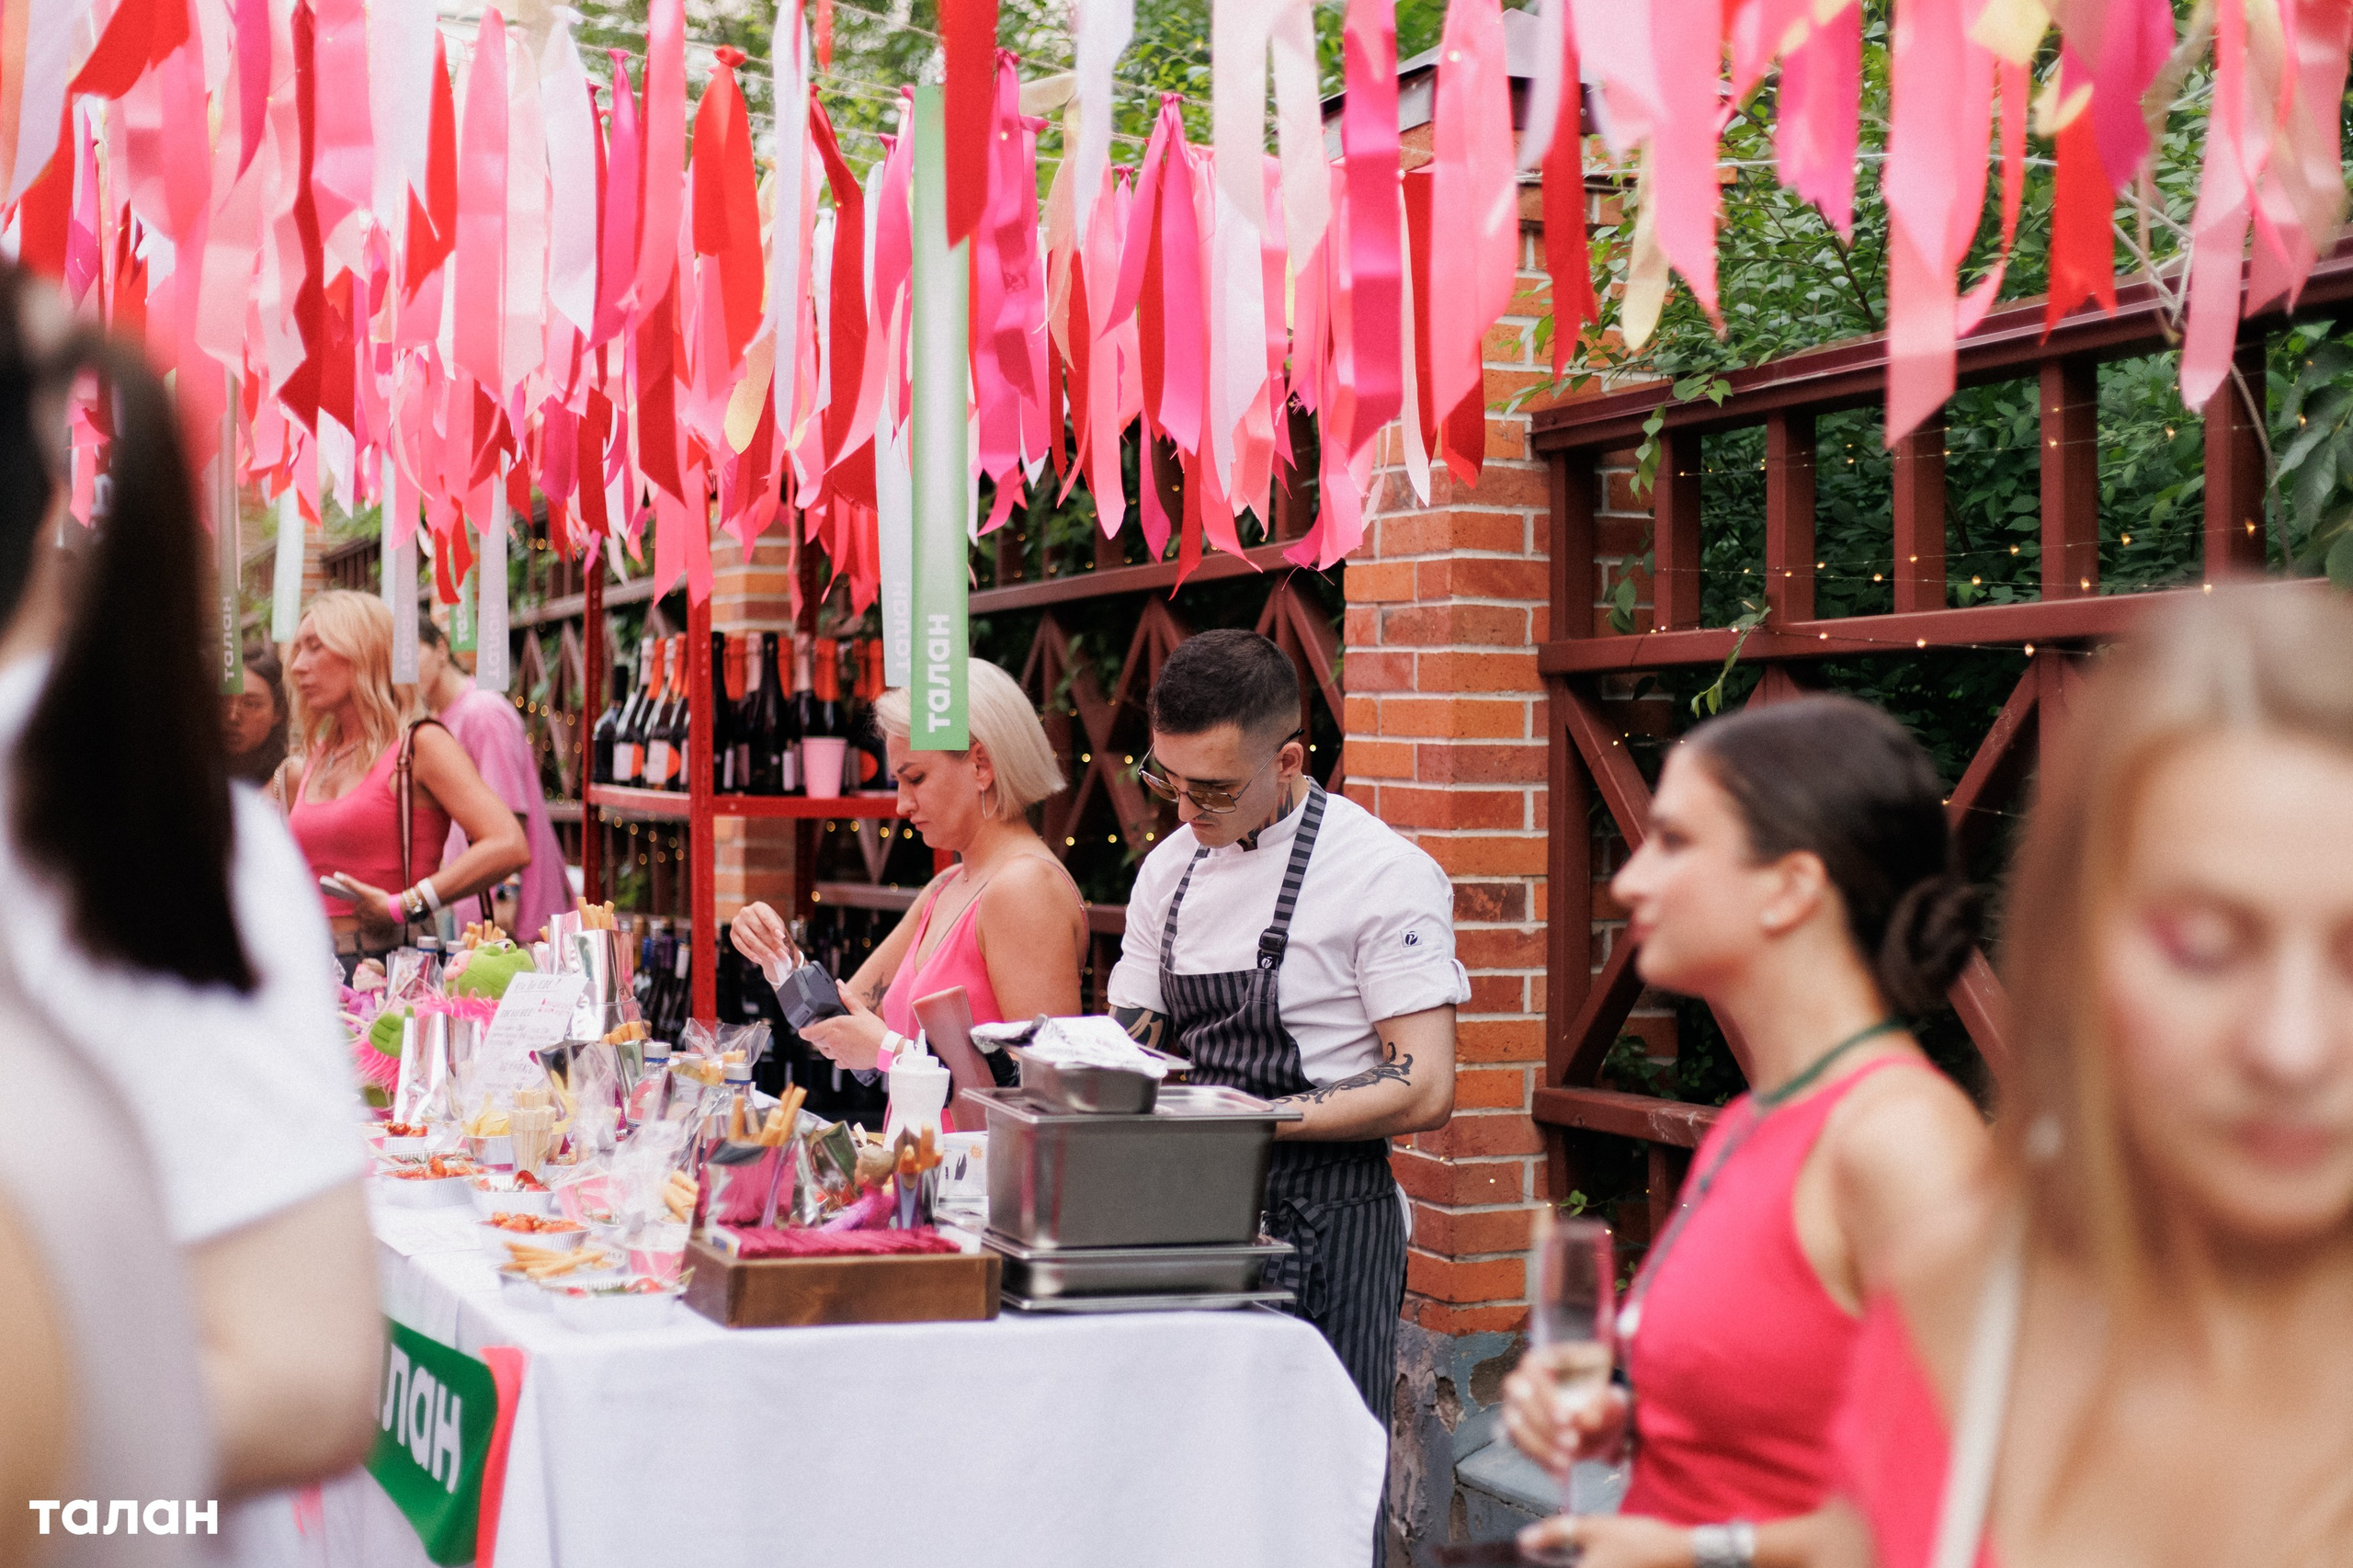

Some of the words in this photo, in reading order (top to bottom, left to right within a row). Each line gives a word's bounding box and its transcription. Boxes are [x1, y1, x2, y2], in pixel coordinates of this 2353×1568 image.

[222, 597, 234, 682] талан
[927, 614, 951, 733] талан
[381, 1342, 461, 1494] лан
